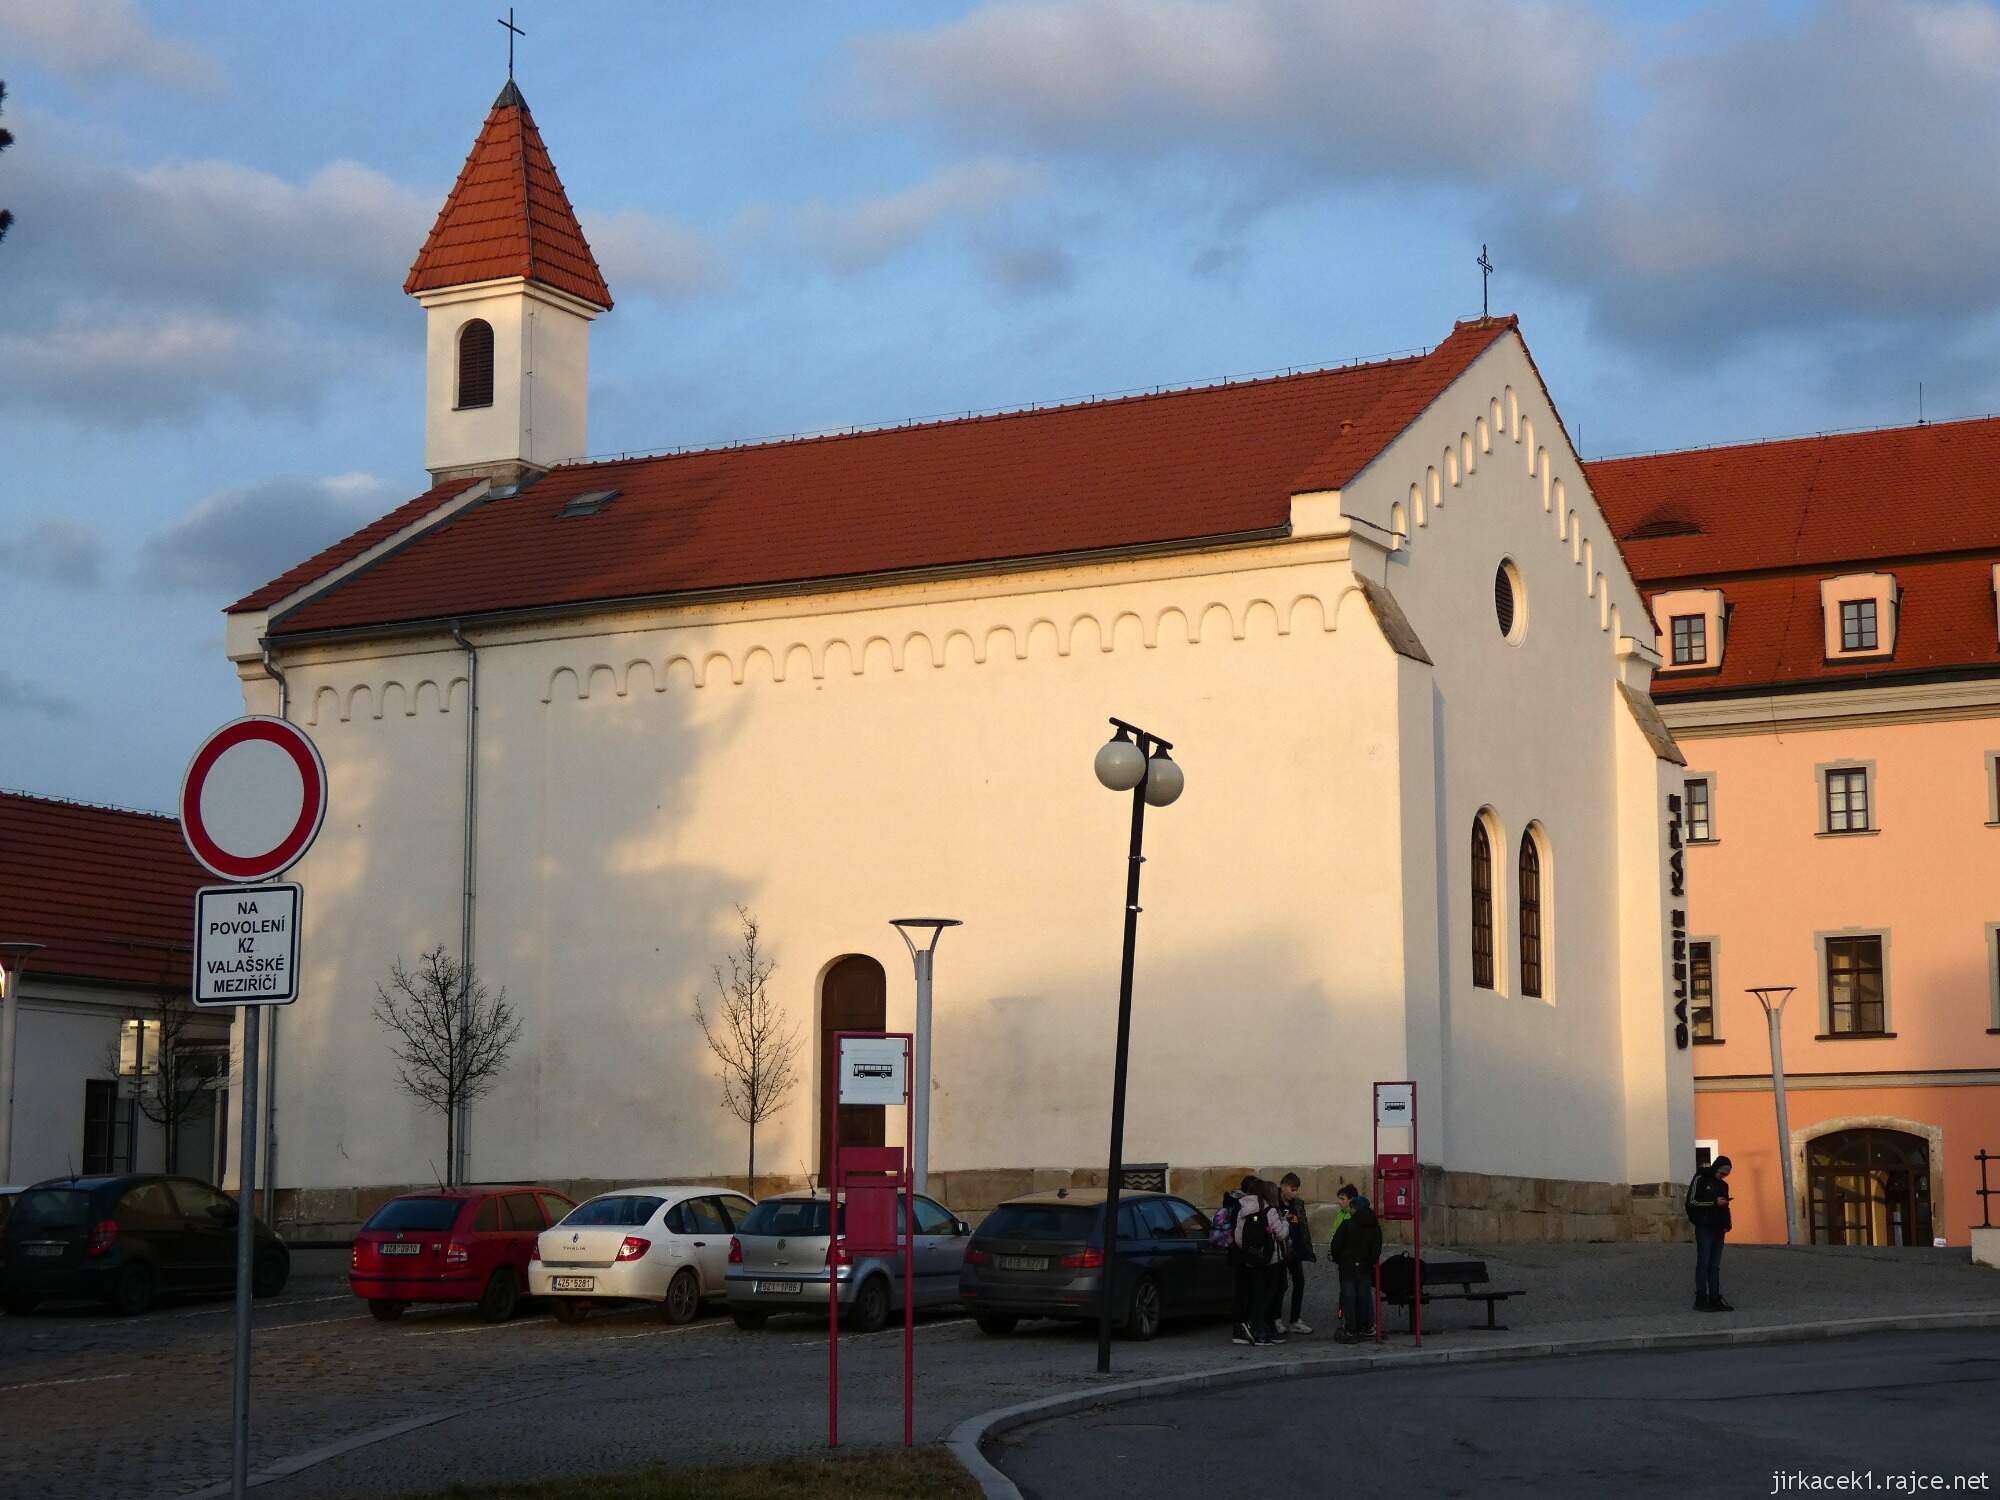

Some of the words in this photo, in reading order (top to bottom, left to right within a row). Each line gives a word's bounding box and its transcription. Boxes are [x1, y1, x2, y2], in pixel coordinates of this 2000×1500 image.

[1668, 794, 1684, 896] KAPLE
[238, 901, 258, 915] NA
[209, 915, 285, 935] POVOLENÍ
[238, 937, 255, 953] KZ
[207, 954, 285, 974] VALAŠSKÉ
[213, 973, 277, 993] MEZIŘÍČÍ
[1670, 909, 1688, 1050] GALERIE
